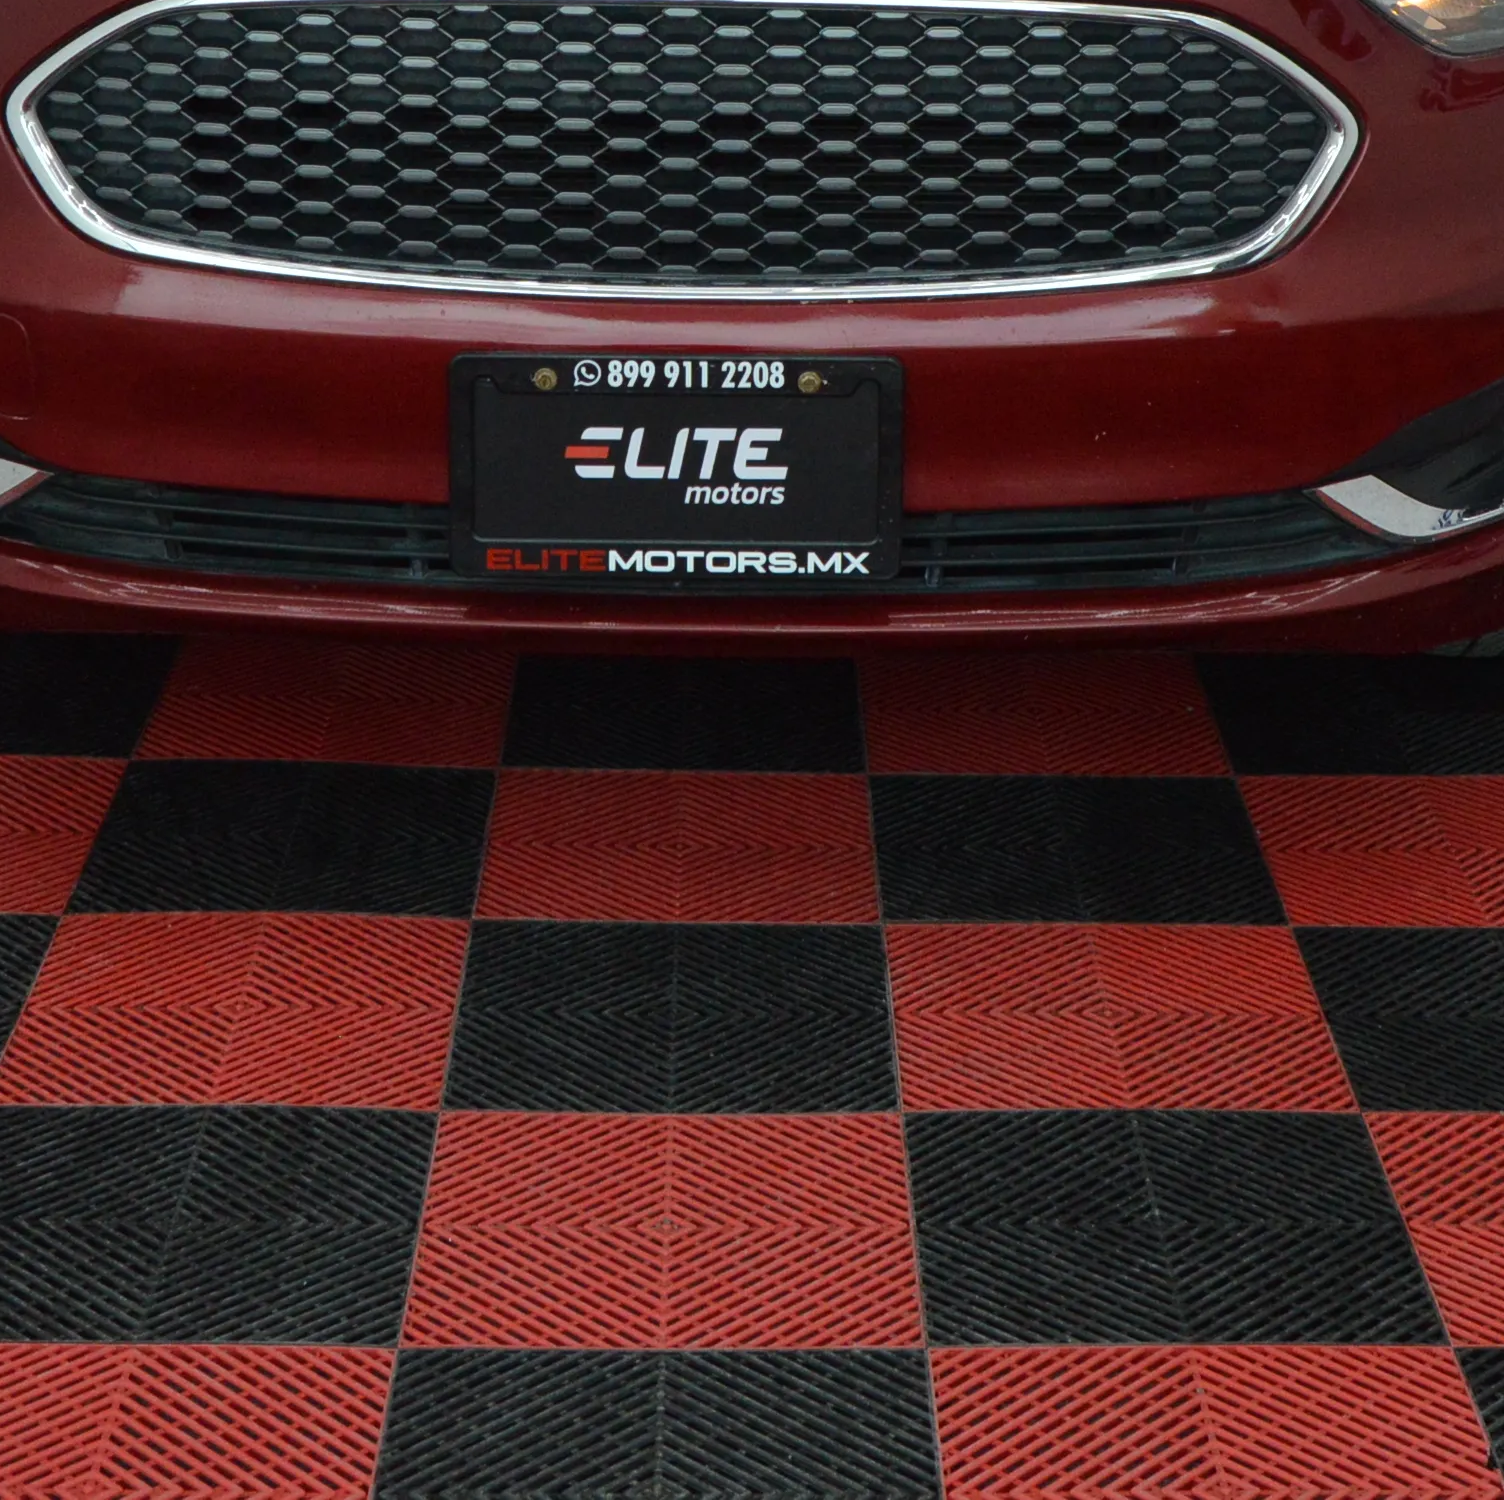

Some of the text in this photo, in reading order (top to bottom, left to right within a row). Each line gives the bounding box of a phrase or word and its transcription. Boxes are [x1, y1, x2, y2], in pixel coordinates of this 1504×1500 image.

[607, 359, 786, 389] 899 911 2208
[564, 426, 789, 480] ELITE
[683, 483, 786, 505] motors
[486, 548, 870, 575] ELITEMOTORS.MX
